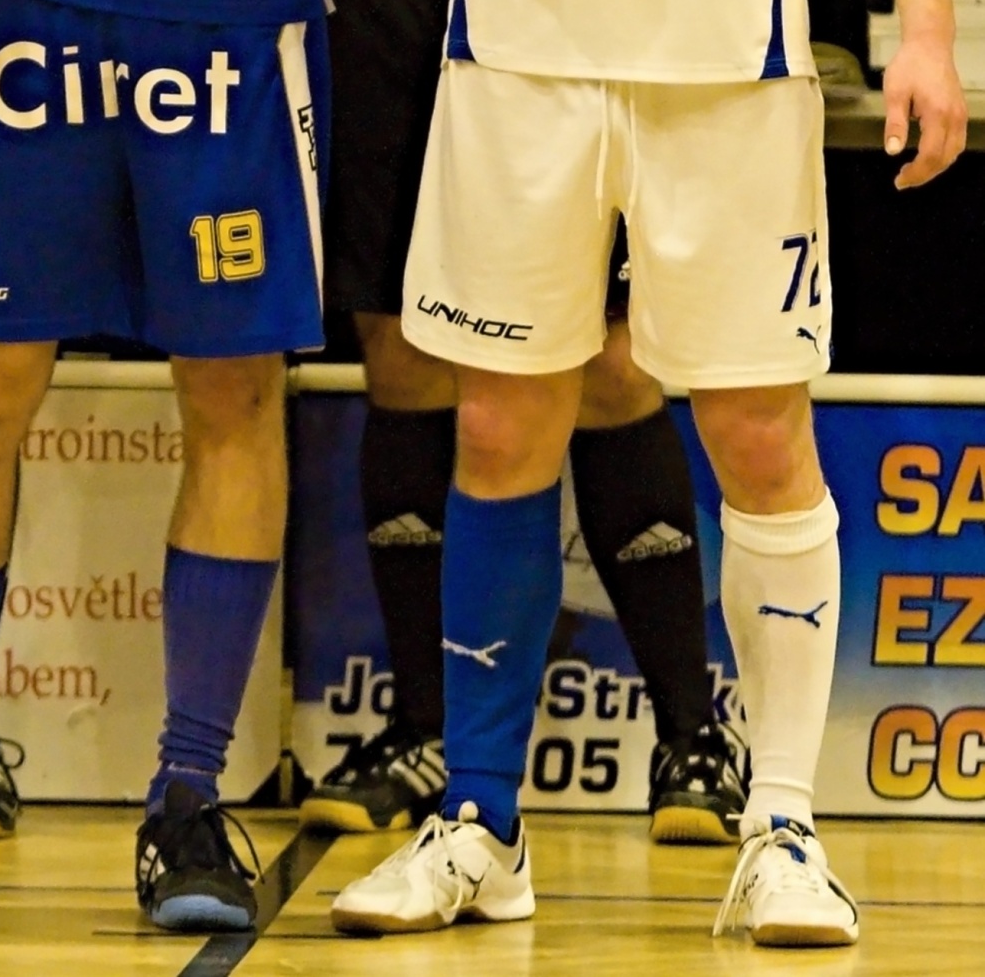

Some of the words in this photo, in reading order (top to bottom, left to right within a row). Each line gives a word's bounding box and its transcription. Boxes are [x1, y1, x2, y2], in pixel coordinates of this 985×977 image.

[189, 209, 265, 282] 19
[417, 294, 533, 341] UNIHOC
[21, 414, 185, 463] troinsta
[7, 571, 163, 622] osvětle
